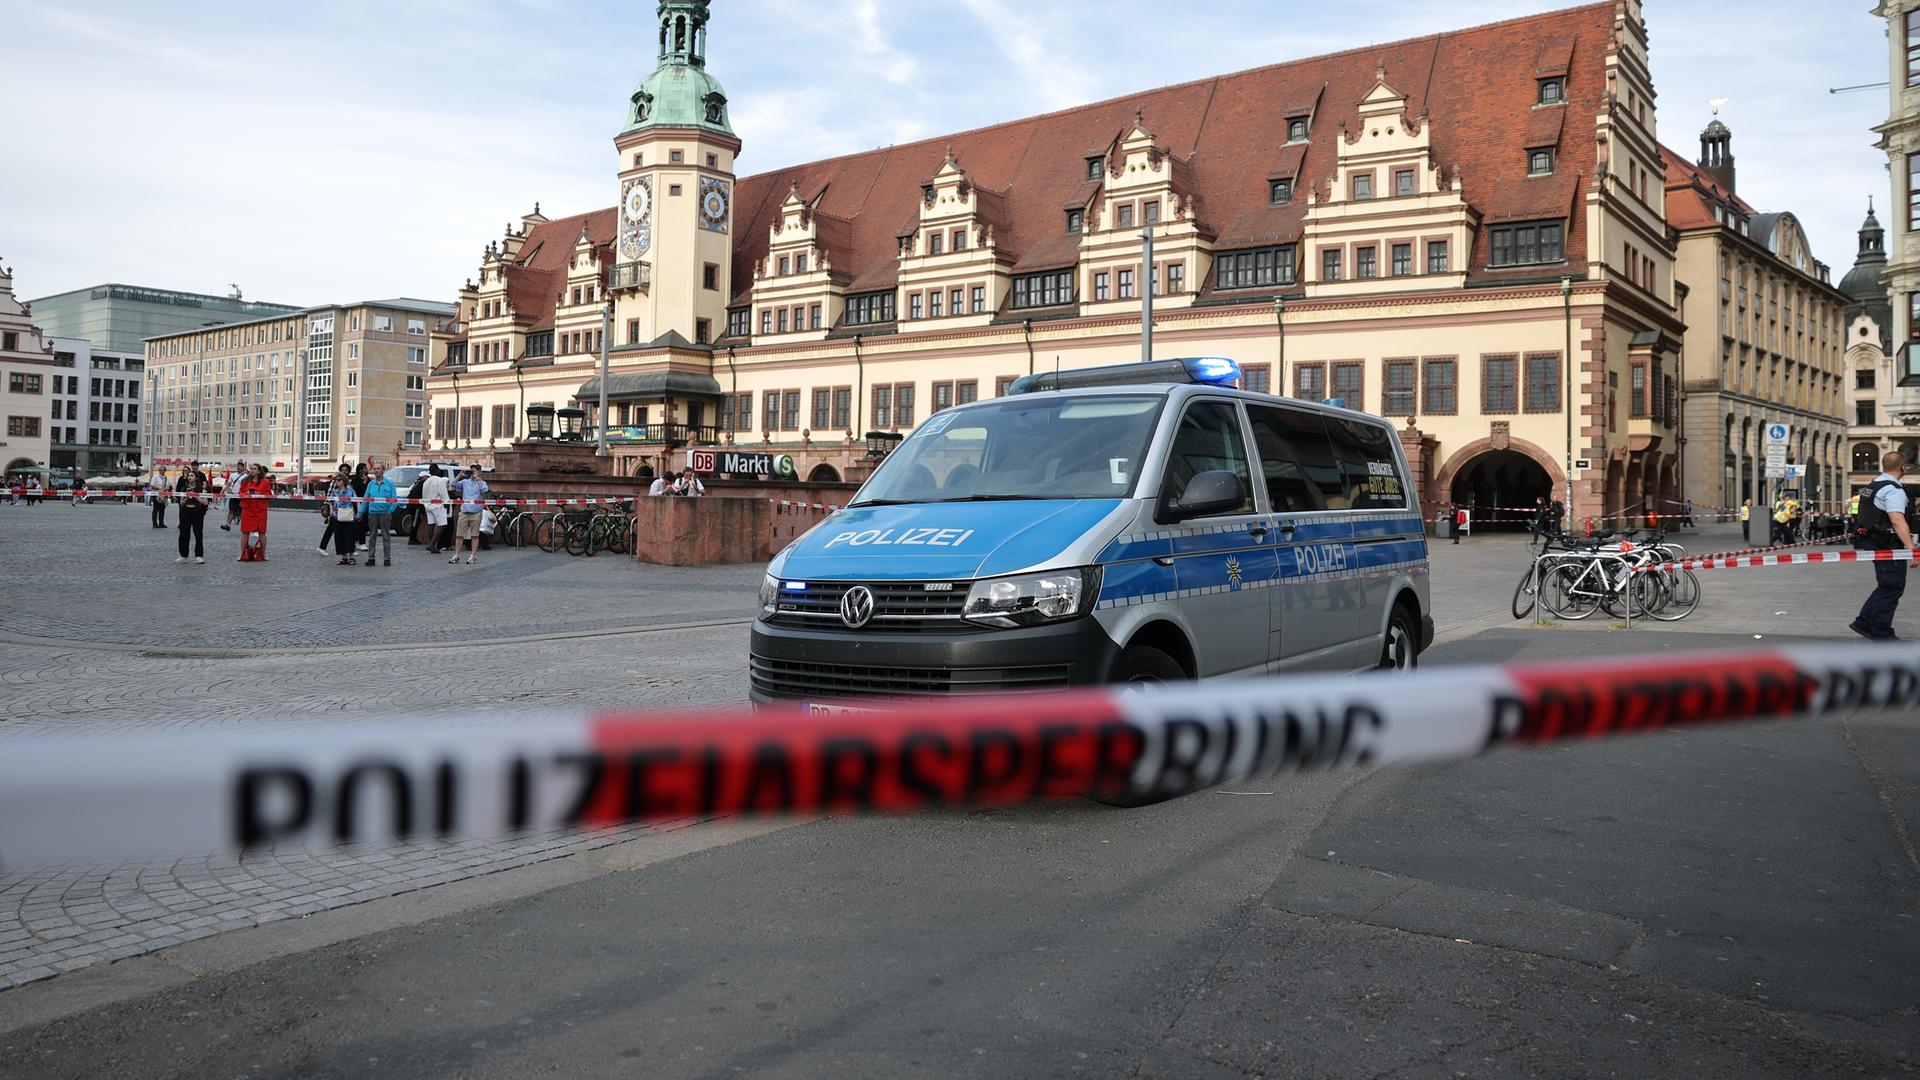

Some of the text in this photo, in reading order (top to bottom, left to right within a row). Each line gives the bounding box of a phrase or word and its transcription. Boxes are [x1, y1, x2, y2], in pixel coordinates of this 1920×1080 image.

[695, 453, 792, 474] DB Markt S
[823, 527, 976, 549] POLIZEI
[1294, 543, 1348, 576] POLIZEI
